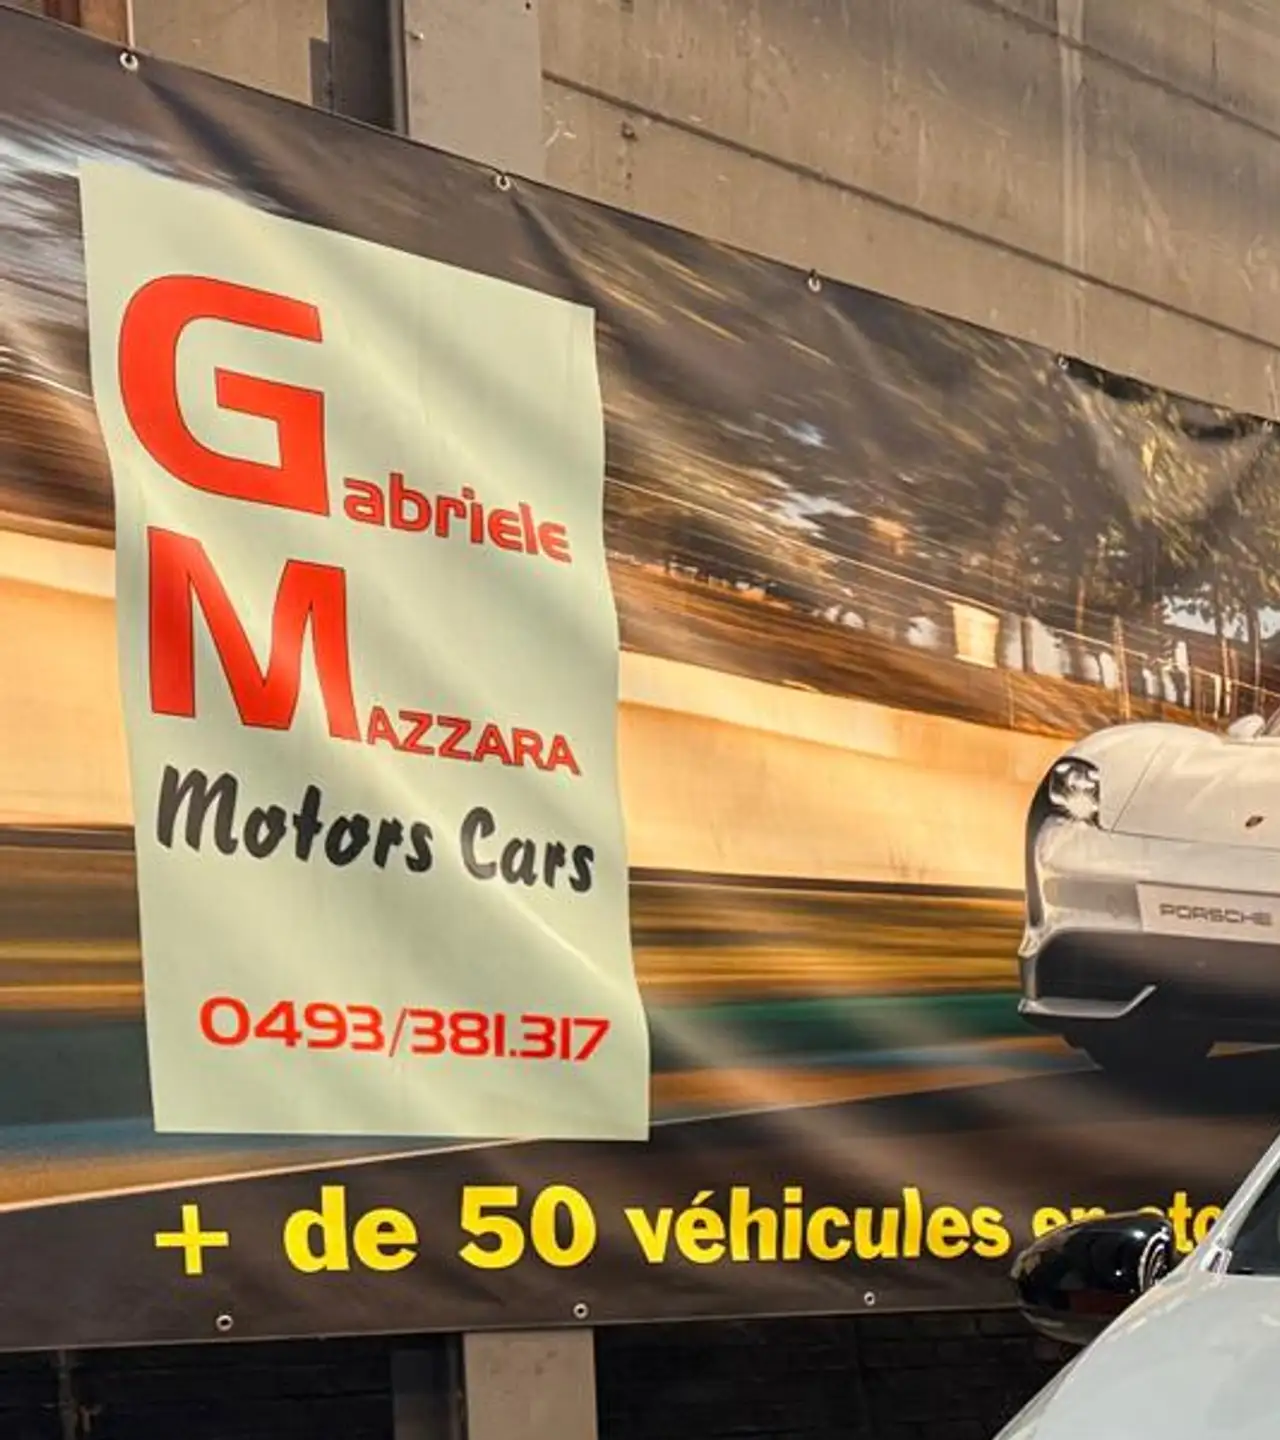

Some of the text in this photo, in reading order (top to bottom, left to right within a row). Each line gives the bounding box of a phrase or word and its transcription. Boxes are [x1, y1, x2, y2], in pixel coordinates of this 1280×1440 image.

[156, 764, 595, 892] Motors Cars
[1159, 903, 1273, 926] PORSCHE
[199, 996, 610, 1062] 0493/381.317
[284, 1185, 418, 1272] de
[458, 1184, 597, 1268] 50
[624, 1186, 1010, 1264] véhicules
